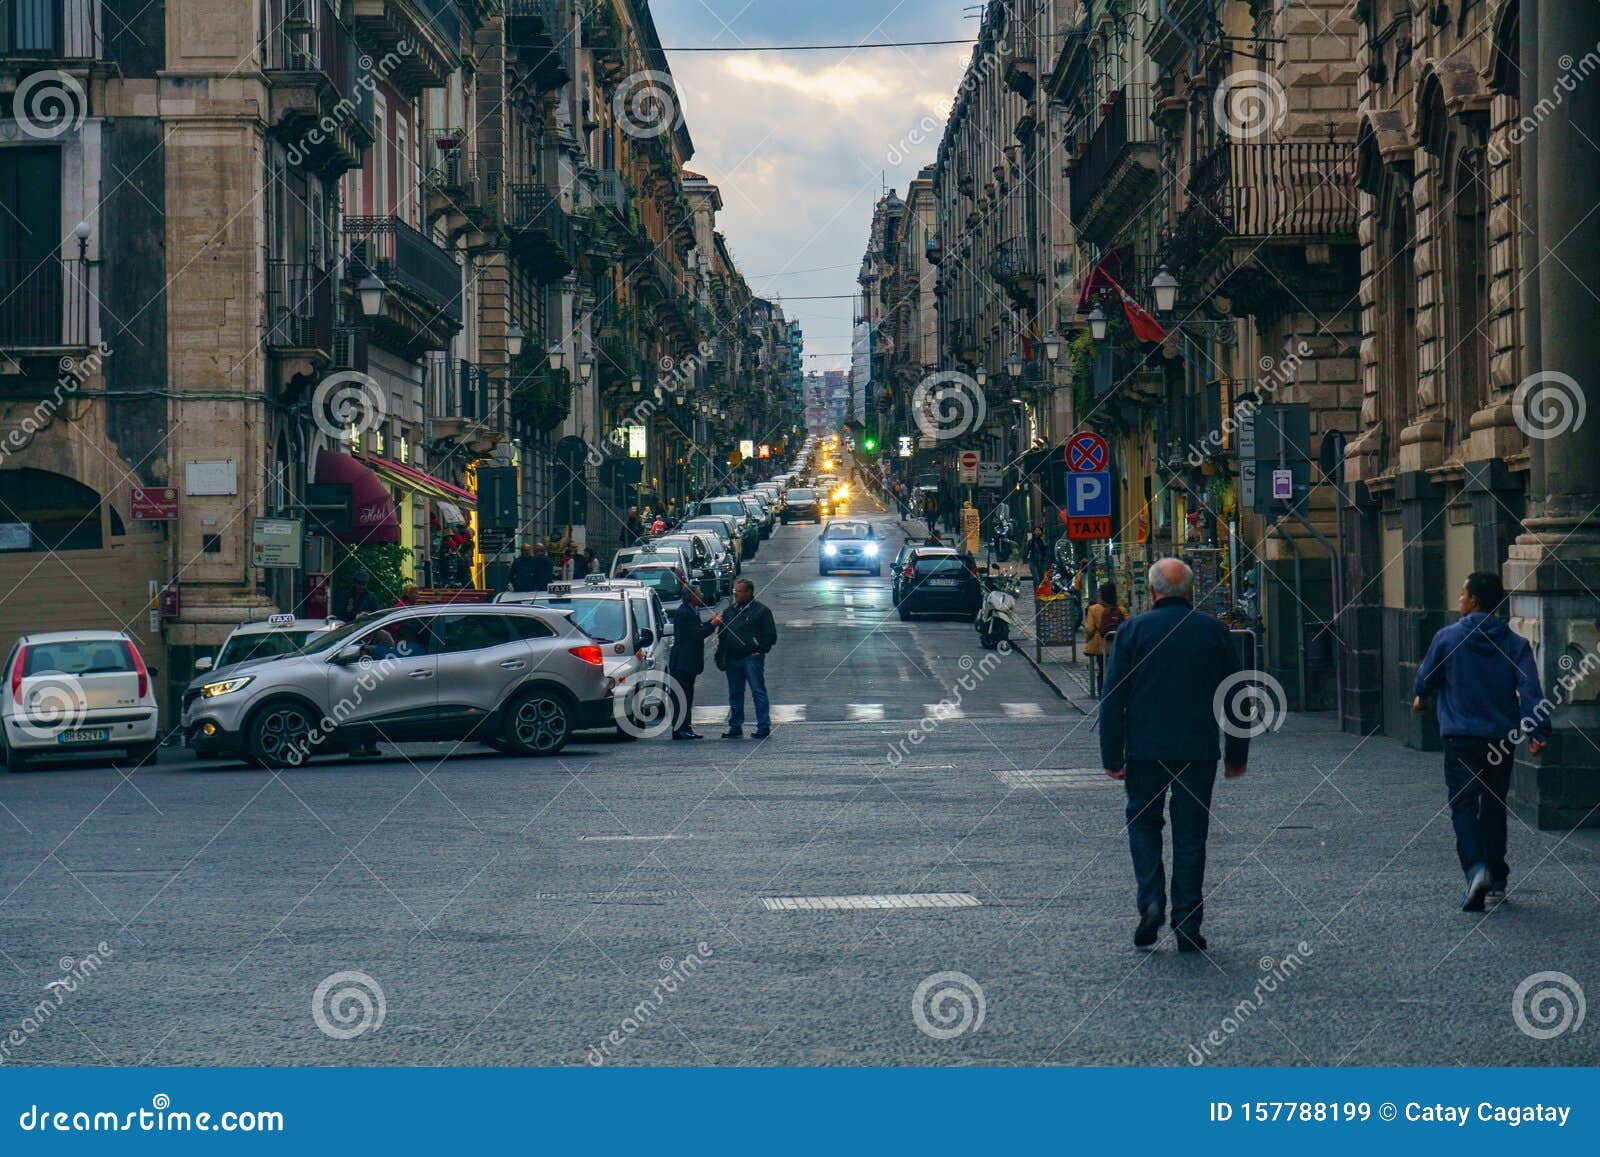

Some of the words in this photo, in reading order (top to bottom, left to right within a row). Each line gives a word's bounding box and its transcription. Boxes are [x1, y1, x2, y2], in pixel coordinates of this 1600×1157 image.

[1076, 477, 1101, 511] P
[1072, 522, 1107, 534] TAXI
[271, 615, 292, 623] TAXI
